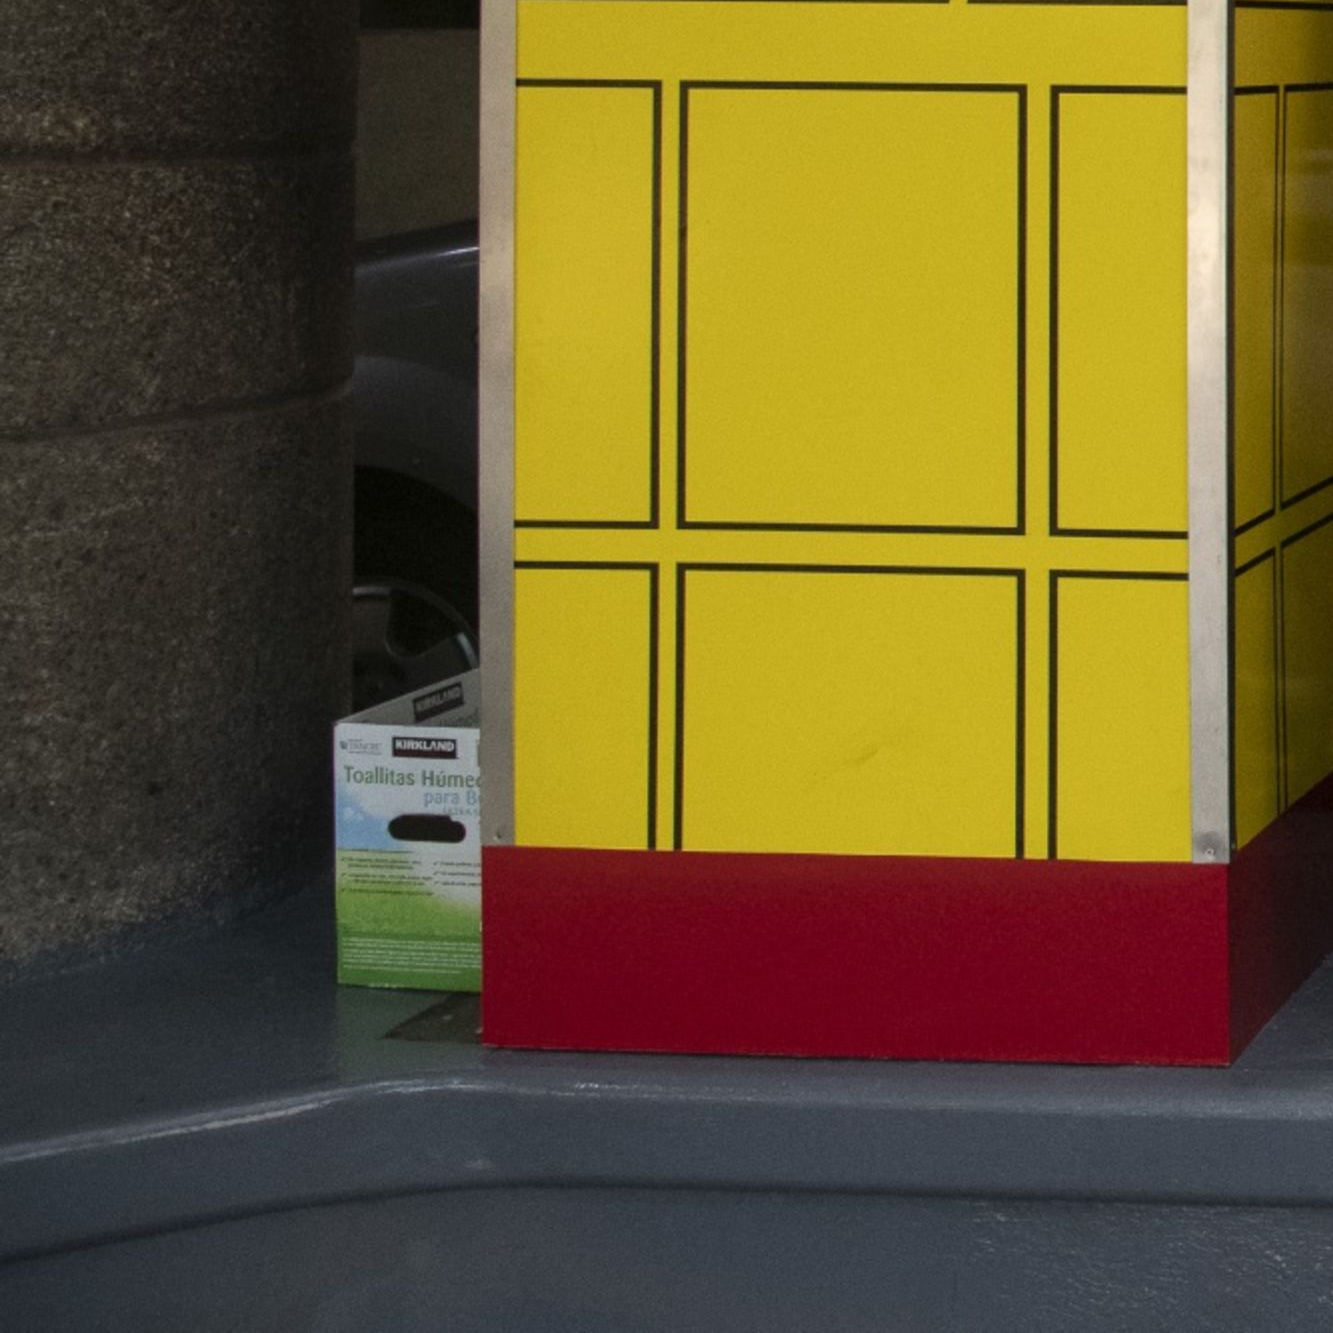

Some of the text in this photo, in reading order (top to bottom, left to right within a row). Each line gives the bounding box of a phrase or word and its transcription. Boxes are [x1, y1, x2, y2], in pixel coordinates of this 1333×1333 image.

[395, 738, 456, 753] KIRKLAND
[344, 765, 416, 787] Toallitas
[423, 789, 480, 807] para B
